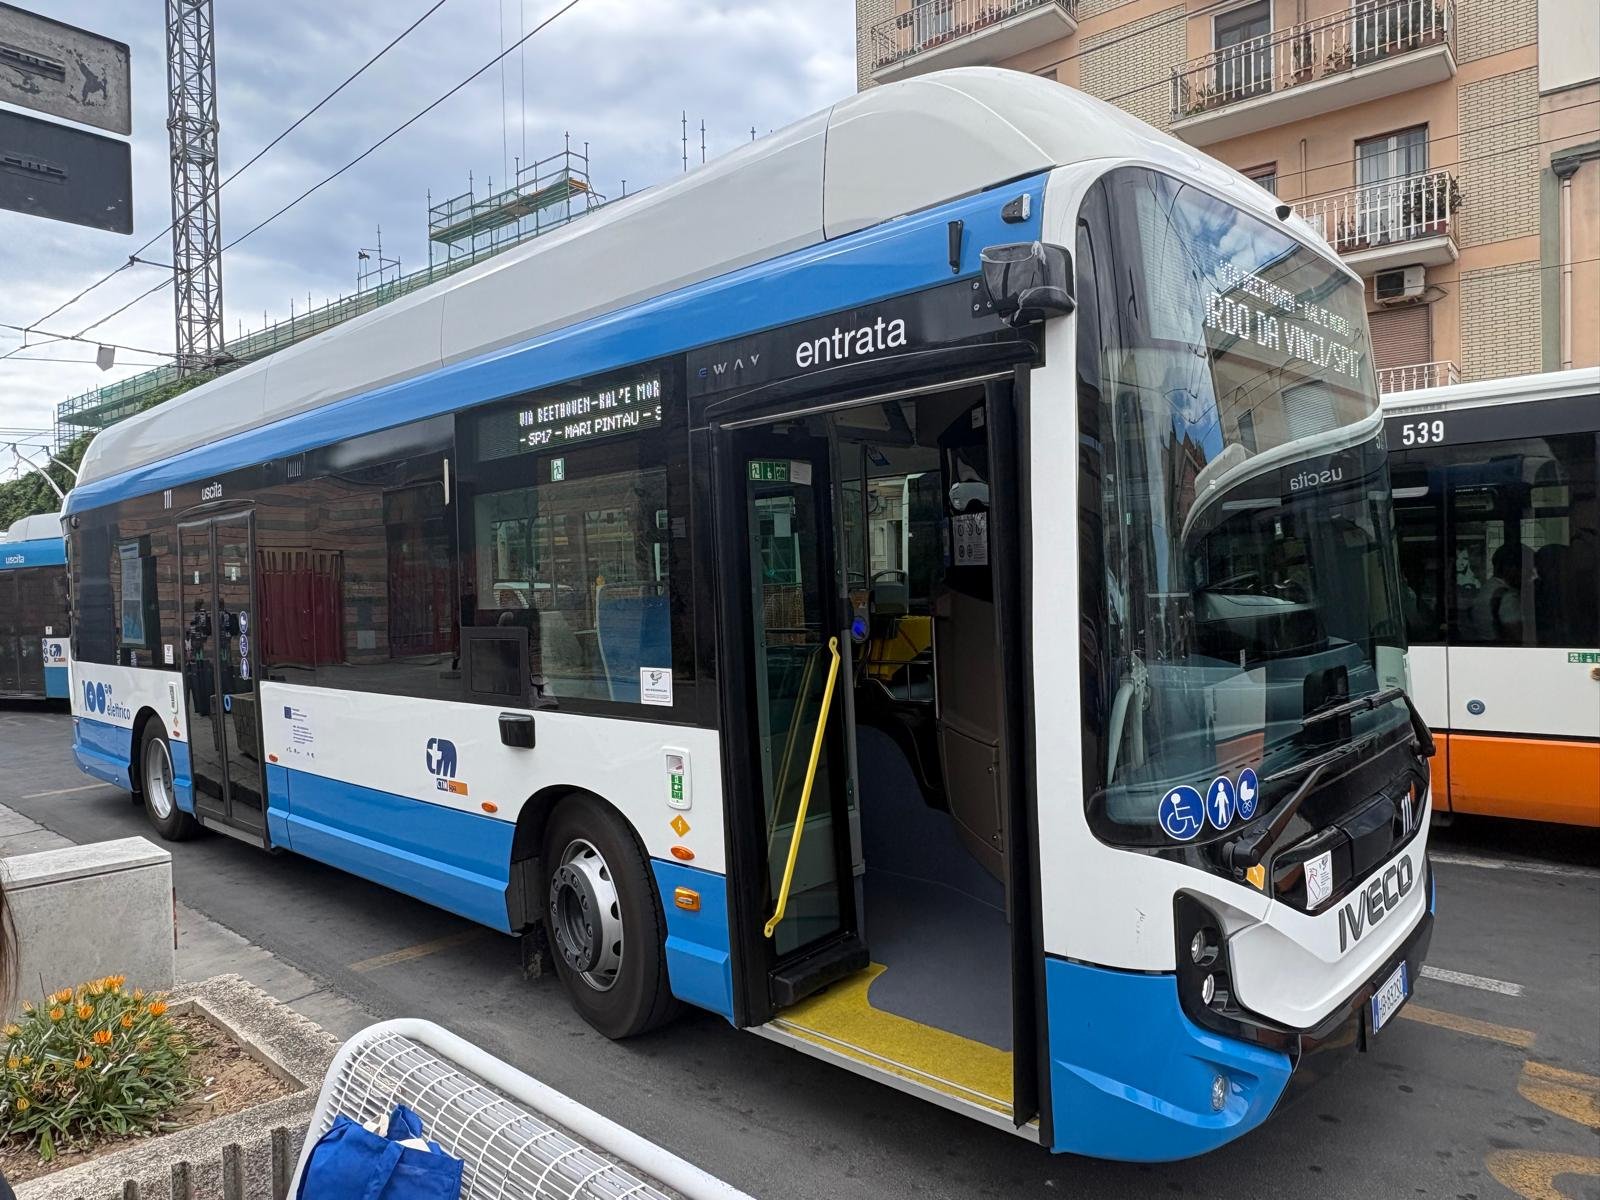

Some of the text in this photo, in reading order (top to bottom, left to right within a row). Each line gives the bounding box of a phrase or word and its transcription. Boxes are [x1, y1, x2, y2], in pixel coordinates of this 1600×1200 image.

[796, 316, 907, 368] entrata
[1257, 310, 1280, 351] DA
[519, 410, 534, 427] VIA
[636, 379, 661, 401] MOR
[528, 429, 552, 446] SP17
[565, 420, 592, 439] MARI
[594, 410, 640, 433] PINTAU
[1402, 420, 1444, 446] 539
[201, 481, 222, 500] uscita
[1401, 792, 1413, 837] 111
[1338, 854, 1413, 954] IVECO
